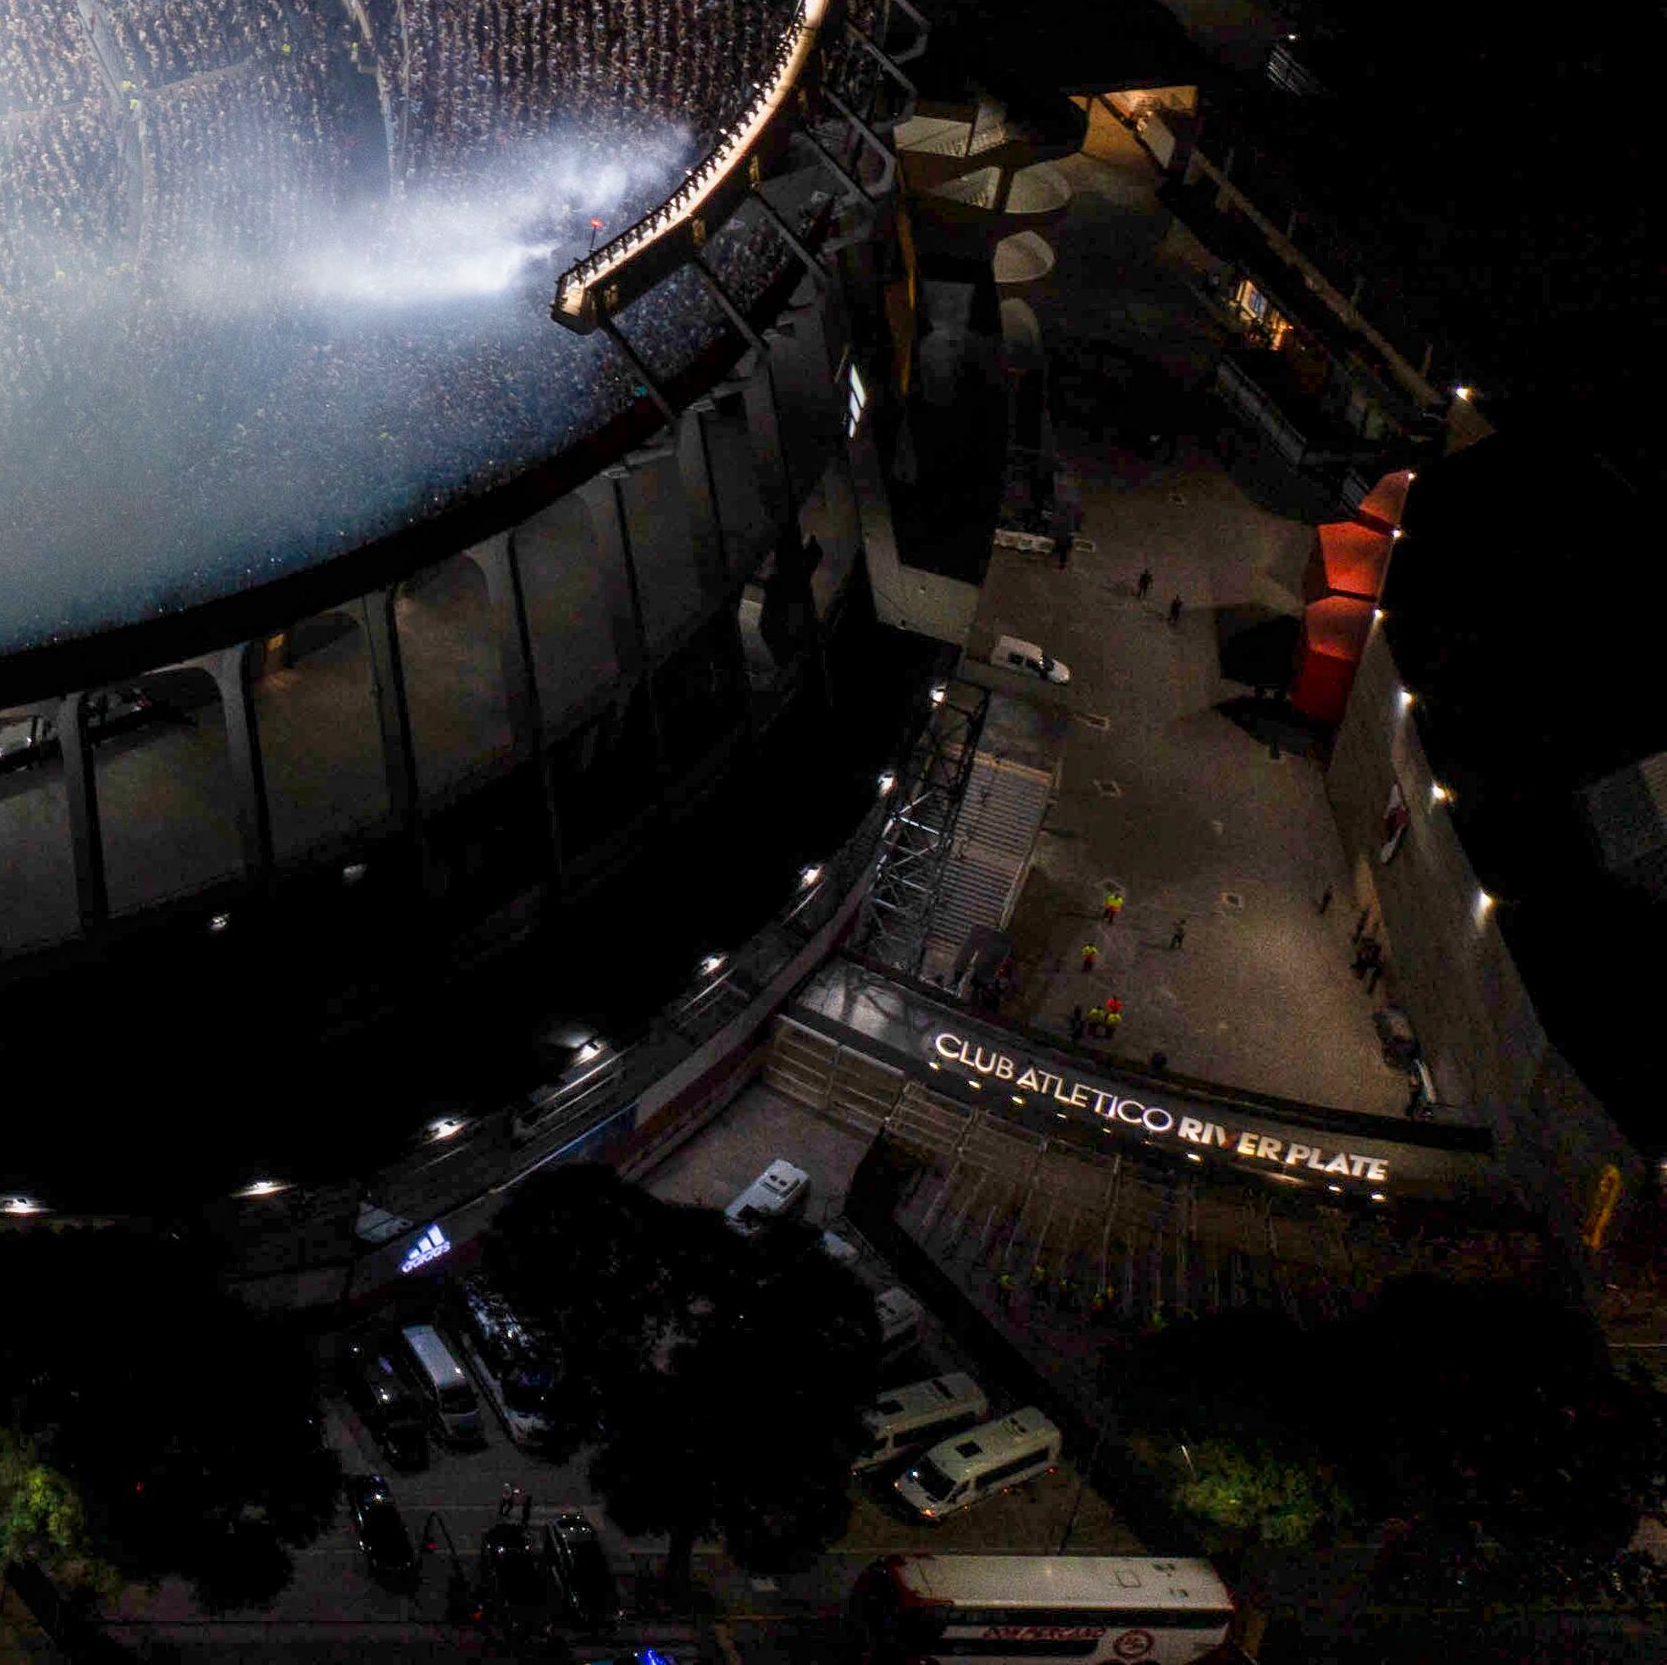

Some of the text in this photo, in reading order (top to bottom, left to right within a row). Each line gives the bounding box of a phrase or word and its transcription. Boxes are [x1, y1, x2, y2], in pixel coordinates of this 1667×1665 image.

[935, 1033, 1389, 1181] CLUB ATLETICO RIVER PLATE
[403, 1241, 450, 1273] adidas
